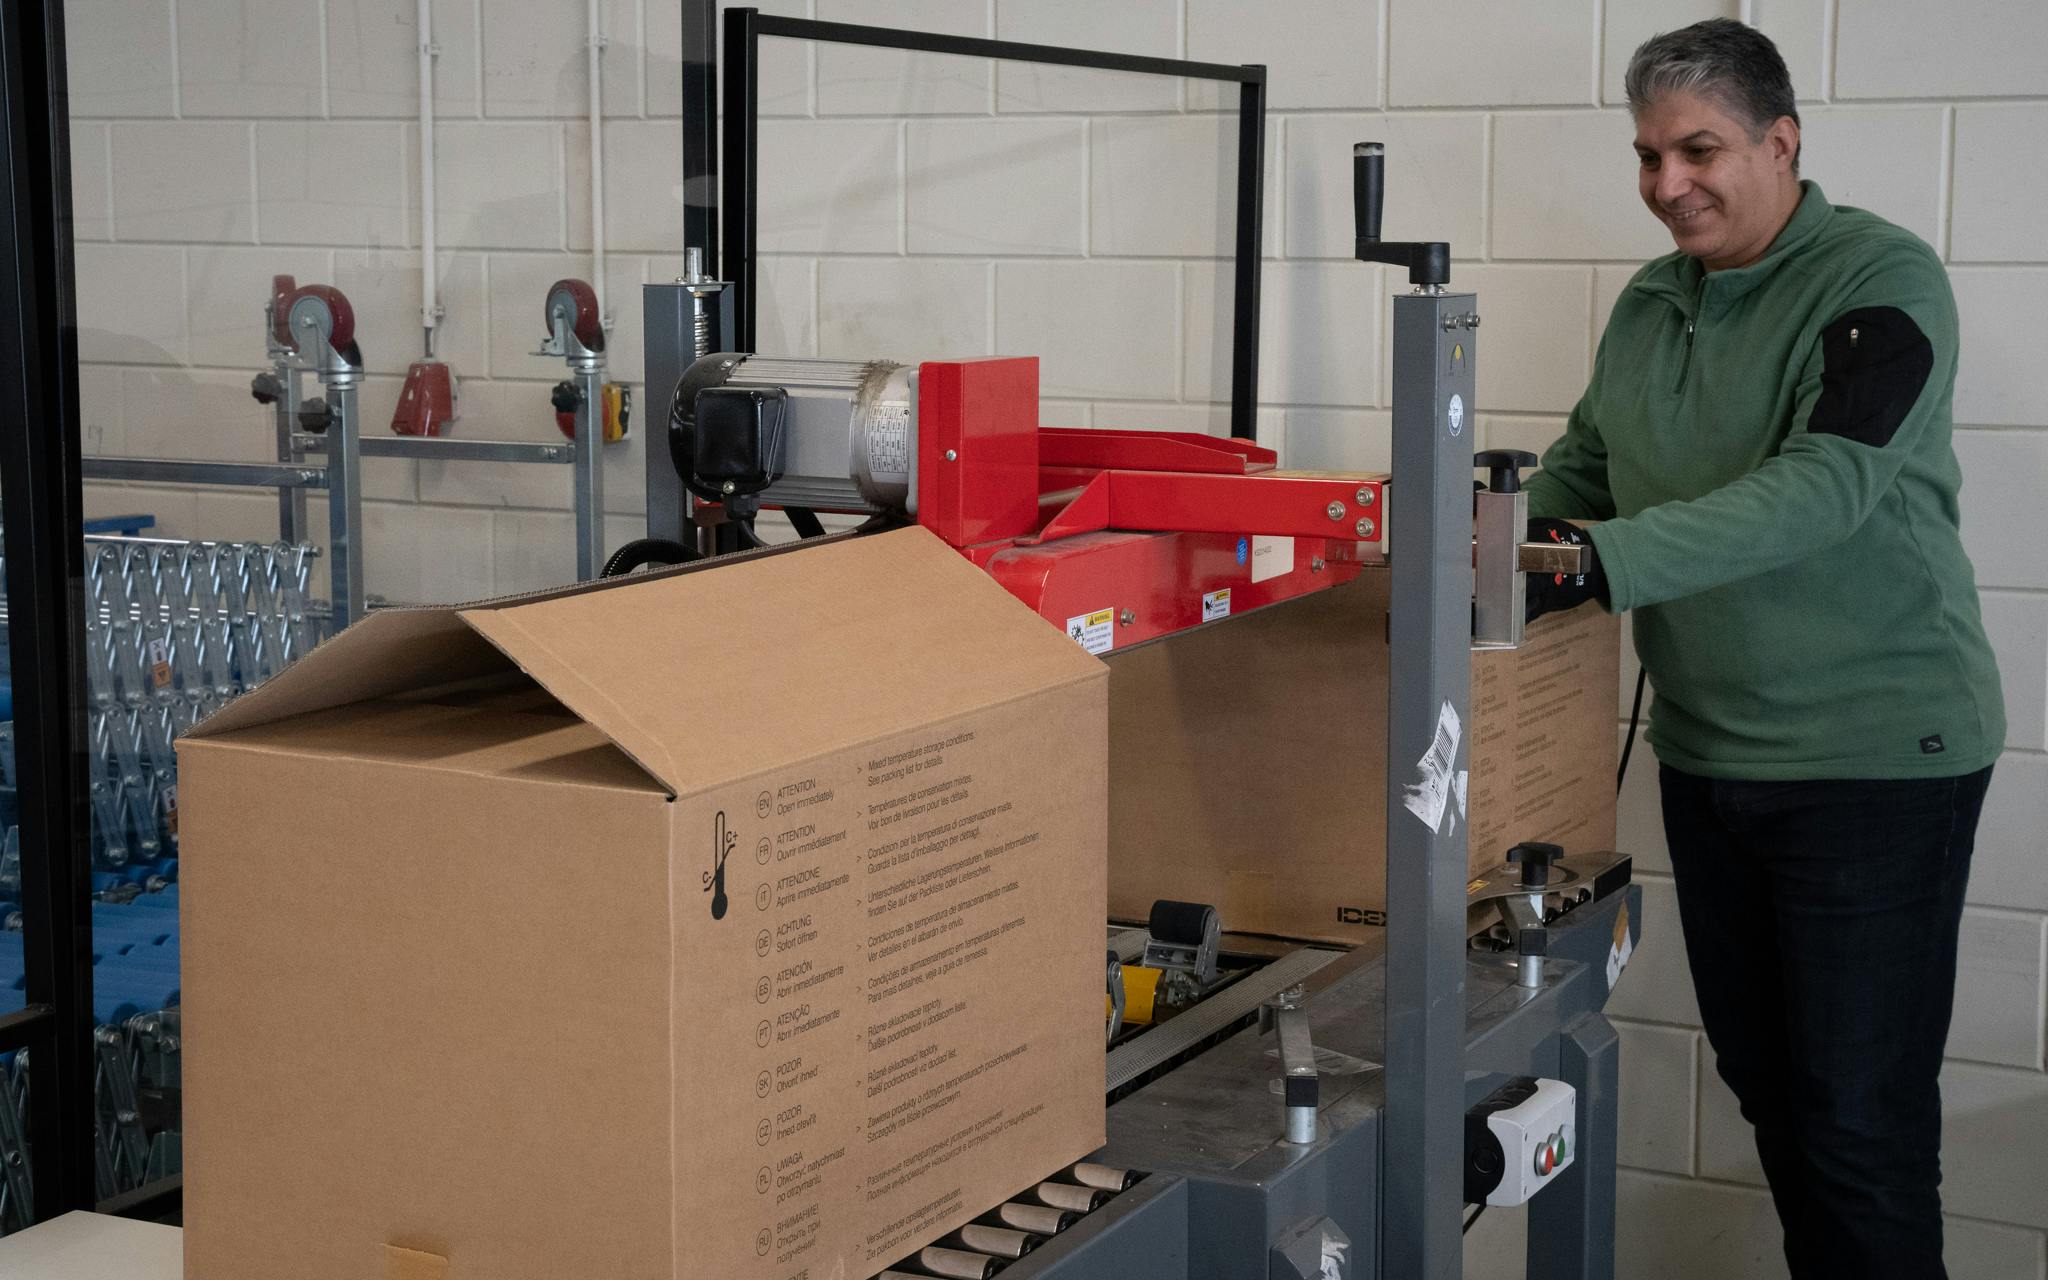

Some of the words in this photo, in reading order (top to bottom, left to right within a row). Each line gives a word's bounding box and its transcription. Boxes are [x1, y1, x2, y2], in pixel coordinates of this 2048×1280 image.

[869, 757, 886, 771] Mixed
[888, 748, 922, 765] temperature
[924, 742, 944, 754] storage
[868, 775, 880, 786] See
[881, 768, 904, 785] packing
[915, 762, 923, 772] for
[777, 778, 816, 799] ATTENTION
[908, 792, 915, 802] de
[918, 781, 953, 799] conservation
[760, 798, 769, 811] EN
[777, 802, 795, 817] Open
[797, 789, 834, 809] immediately
[868, 819, 878, 831] Voir
[881, 816, 892, 827] bon
[893, 813, 901, 822] de
[903, 805, 925, 819] livraison
[927, 801, 939, 814] pour
[941, 797, 949, 807] les
[726, 831, 738, 843] C+
[777, 824, 815, 845] ATTENTION
[868, 840, 898, 859] Condizioni
[900, 838, 909, 850] per
[911, 835, 916, 844] la
[917, 823, 950, 842] temperatura
[952, 819, 957, 829] di
[760, 844, 768, 857] FR
[777, 846, 797, 861] Ouvrir
[868, 859, 890, 874] Guarda
[891, 856, 896, 866] la
[898, 852, 909, 864] lista
[949, 835, 957, 848] per
[777, 867, 820, 891] ATTENZIONE
[761, 891, 766, 902] IT
[776, 893, 796, 908] Aprire
[798, 874, 849, 900] immediatamente
[868, 904, 885, 918] finden
[887, 900, 896, 910] Sie
[898, 894, 907, 906] auf
[909, 892, 918, 902] der
[920, 882, 943, 898] Packliste
[944, 877, 958, 888] oder
[777, 914, 811, 937] ACHTUNG
[868, 926, 904, 948] Condiciones
[906, 922, 913, 933] de
[915, 909, 947, 929] temperatura
[949, 905, 956, 915] de
[759, 936, 768, 949] DE
[776, 936, 796, 953] Sofort
[798, 930, 817, 945] öffnen
[868, 952, 877, 963] Ver
[879, 943, 901, 958] detalles
[903, 939, 910, 949] en
[912, 935, 916, 945] el
[940, 924, 947, 934] de
[777, 959, 812, 983] ATENCIÓN
[868, 969, 899, 989] Condições
[901, 965, 908, 976] de
[956, 942, 964, 952] em
[759, 983, 769, 996] ES
[868, 991, 881, 1004] Para
[883, 985, 897, 998] mais
[925, 968, 936, 980] veja
[938, 966, 941, 975] a
[943, 960, 955, 975] guia
[956, 957, 963, 967] de
[777, 985, 792, 999] Abrir
[777, 1004, 809, 1027] ATENÇÃO
[760, 1027, 768, 1039] PT
[777, 1028, 792, 1043] Abrir
[777, 1057, 801, 1077] POZOR
[760, 1077, 768, 1091] SK
[777, 1104, 801, 1125] POZOR
[898, 1117, 905, 1128] na
[760, 1125, 768, 1138] CZ
[777, 1124, 795, 1141] Ihned
[777, 1151, 803, 1172] UWAGA
[808, 1145, 844, 1173] natychmiast
[760, 1173, 768, 1186] PL
[776, 1192, 785, 1206] po
[760, 1234, 769, 1248] RU
